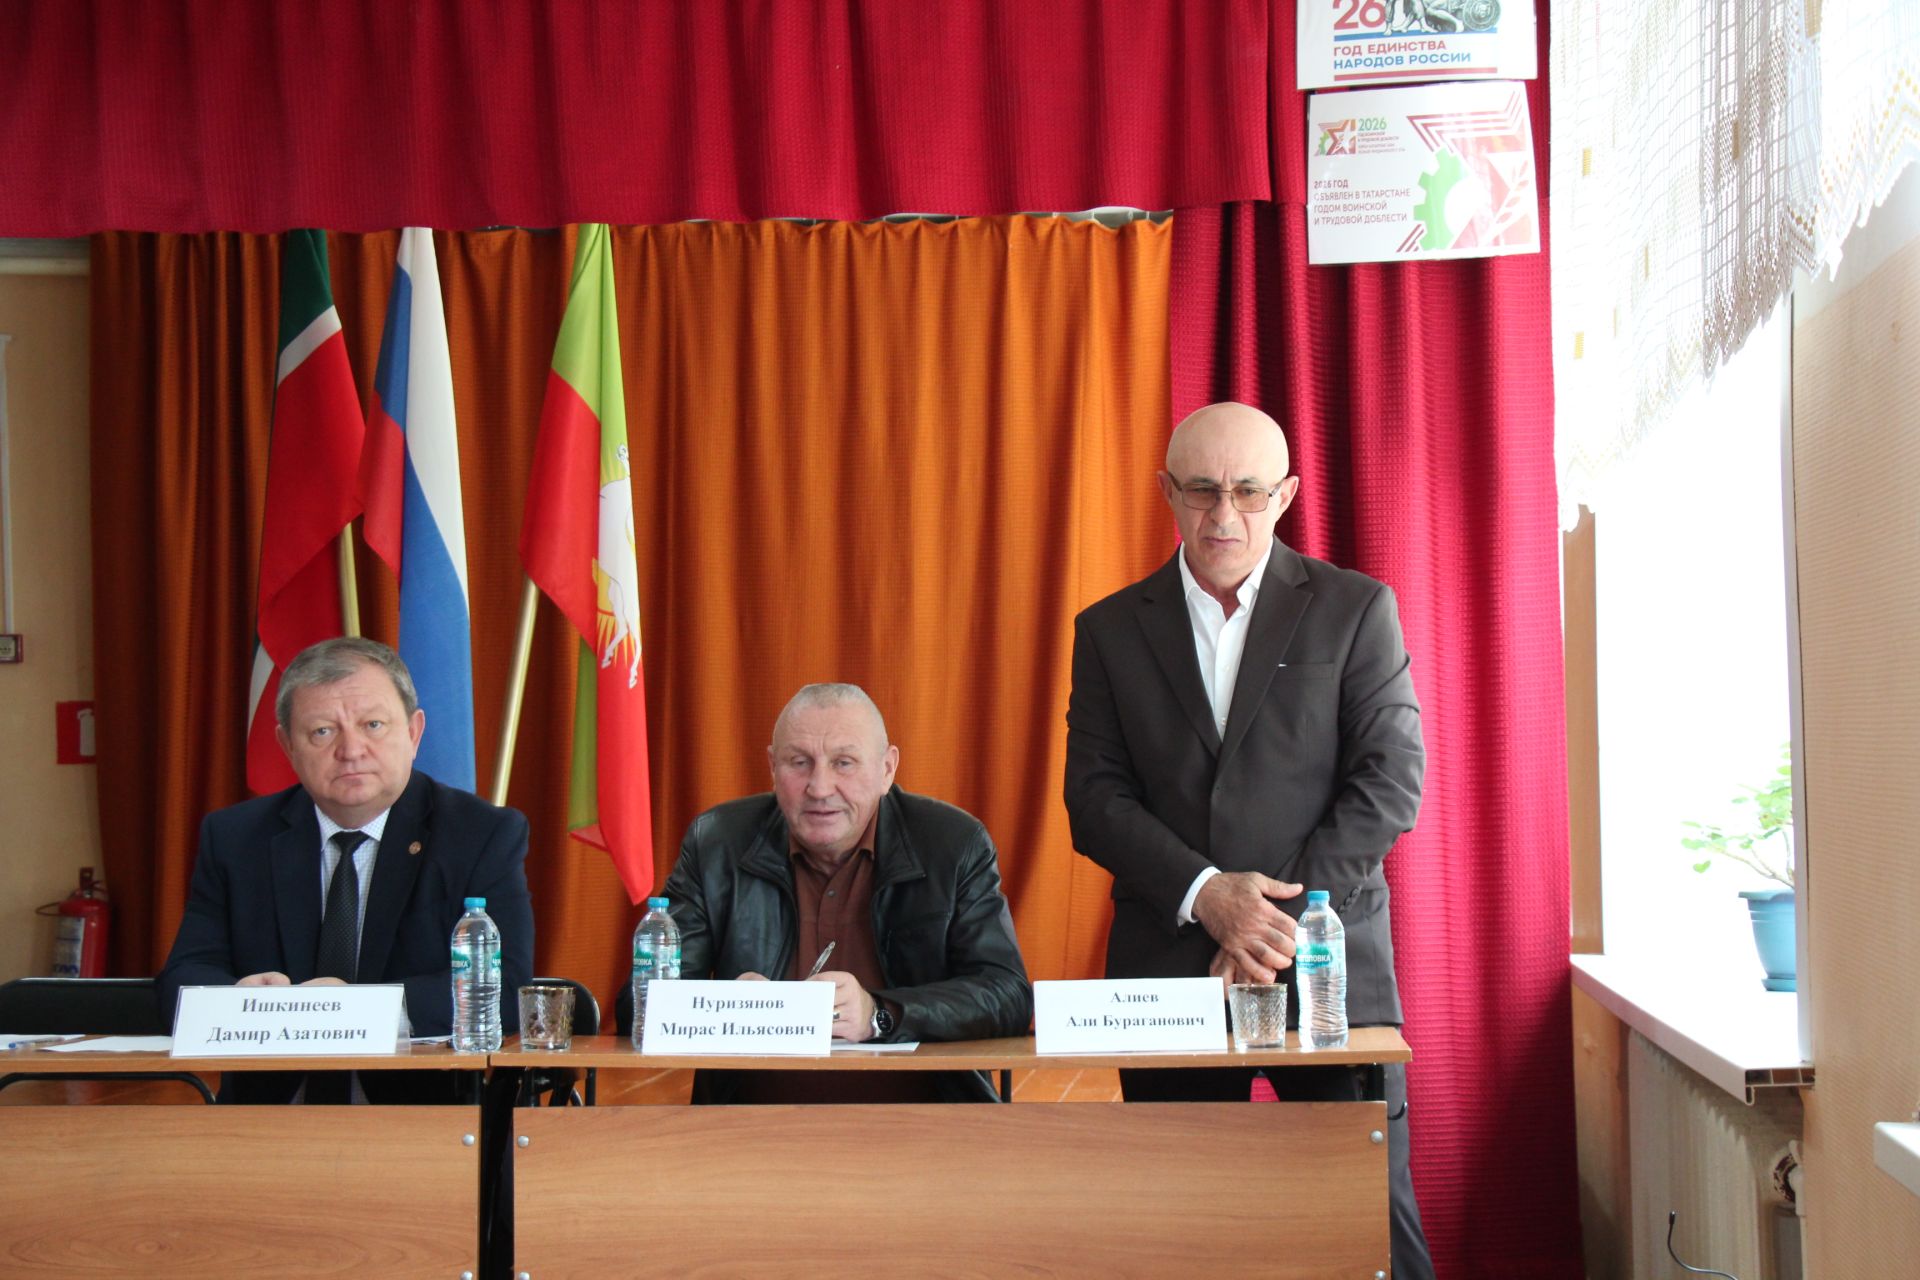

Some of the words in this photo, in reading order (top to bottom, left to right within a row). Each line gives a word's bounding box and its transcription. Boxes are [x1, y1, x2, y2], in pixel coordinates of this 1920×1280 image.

[1332, 0, 1386, 30] 26
[1333, 45, 1363, 57] ГОД
[1367, 40, 1447, 55] ЕДИНСТВА
[1334, 55, 1405, 70] НАРОДОВ
[1409, 52, 1472, 65] РОССИИ
[1358, 117, 1388, 131] 2026
[1333, 179, 1349, 189] ГОД
[1355, 191, 1361, 200] В
[1361, 188, 1411, 199] ТАТАРСТАНЕ
[1313, 203, 1342, 214] ГОДОМ
[1342, 201, 1388, 212] ВОИНСКОЙ
[1314, 217, 1320, 225] И
[1321, 214, 1363, 225] ТРУДОВОЙ
[1364, 213, 1408, 224] ДОБЛЕСТИ
[692, 996, 785, 1013] Нуризянов
[1110, 991, 1160, 1003] Алиев
[241, 998, 342, 1013] Ишкинеев
[1065, 1015, 1098, 1027] Али
[1102, 1014, 1205, 1030] Бураганович
[206, 1026, 271, 1044] Дамир
[276, 1026, 367, 1041] Азатович
[660, 1022, 717, 1039] Мирас
[721, 1022, 816, 1036] Ильясович
